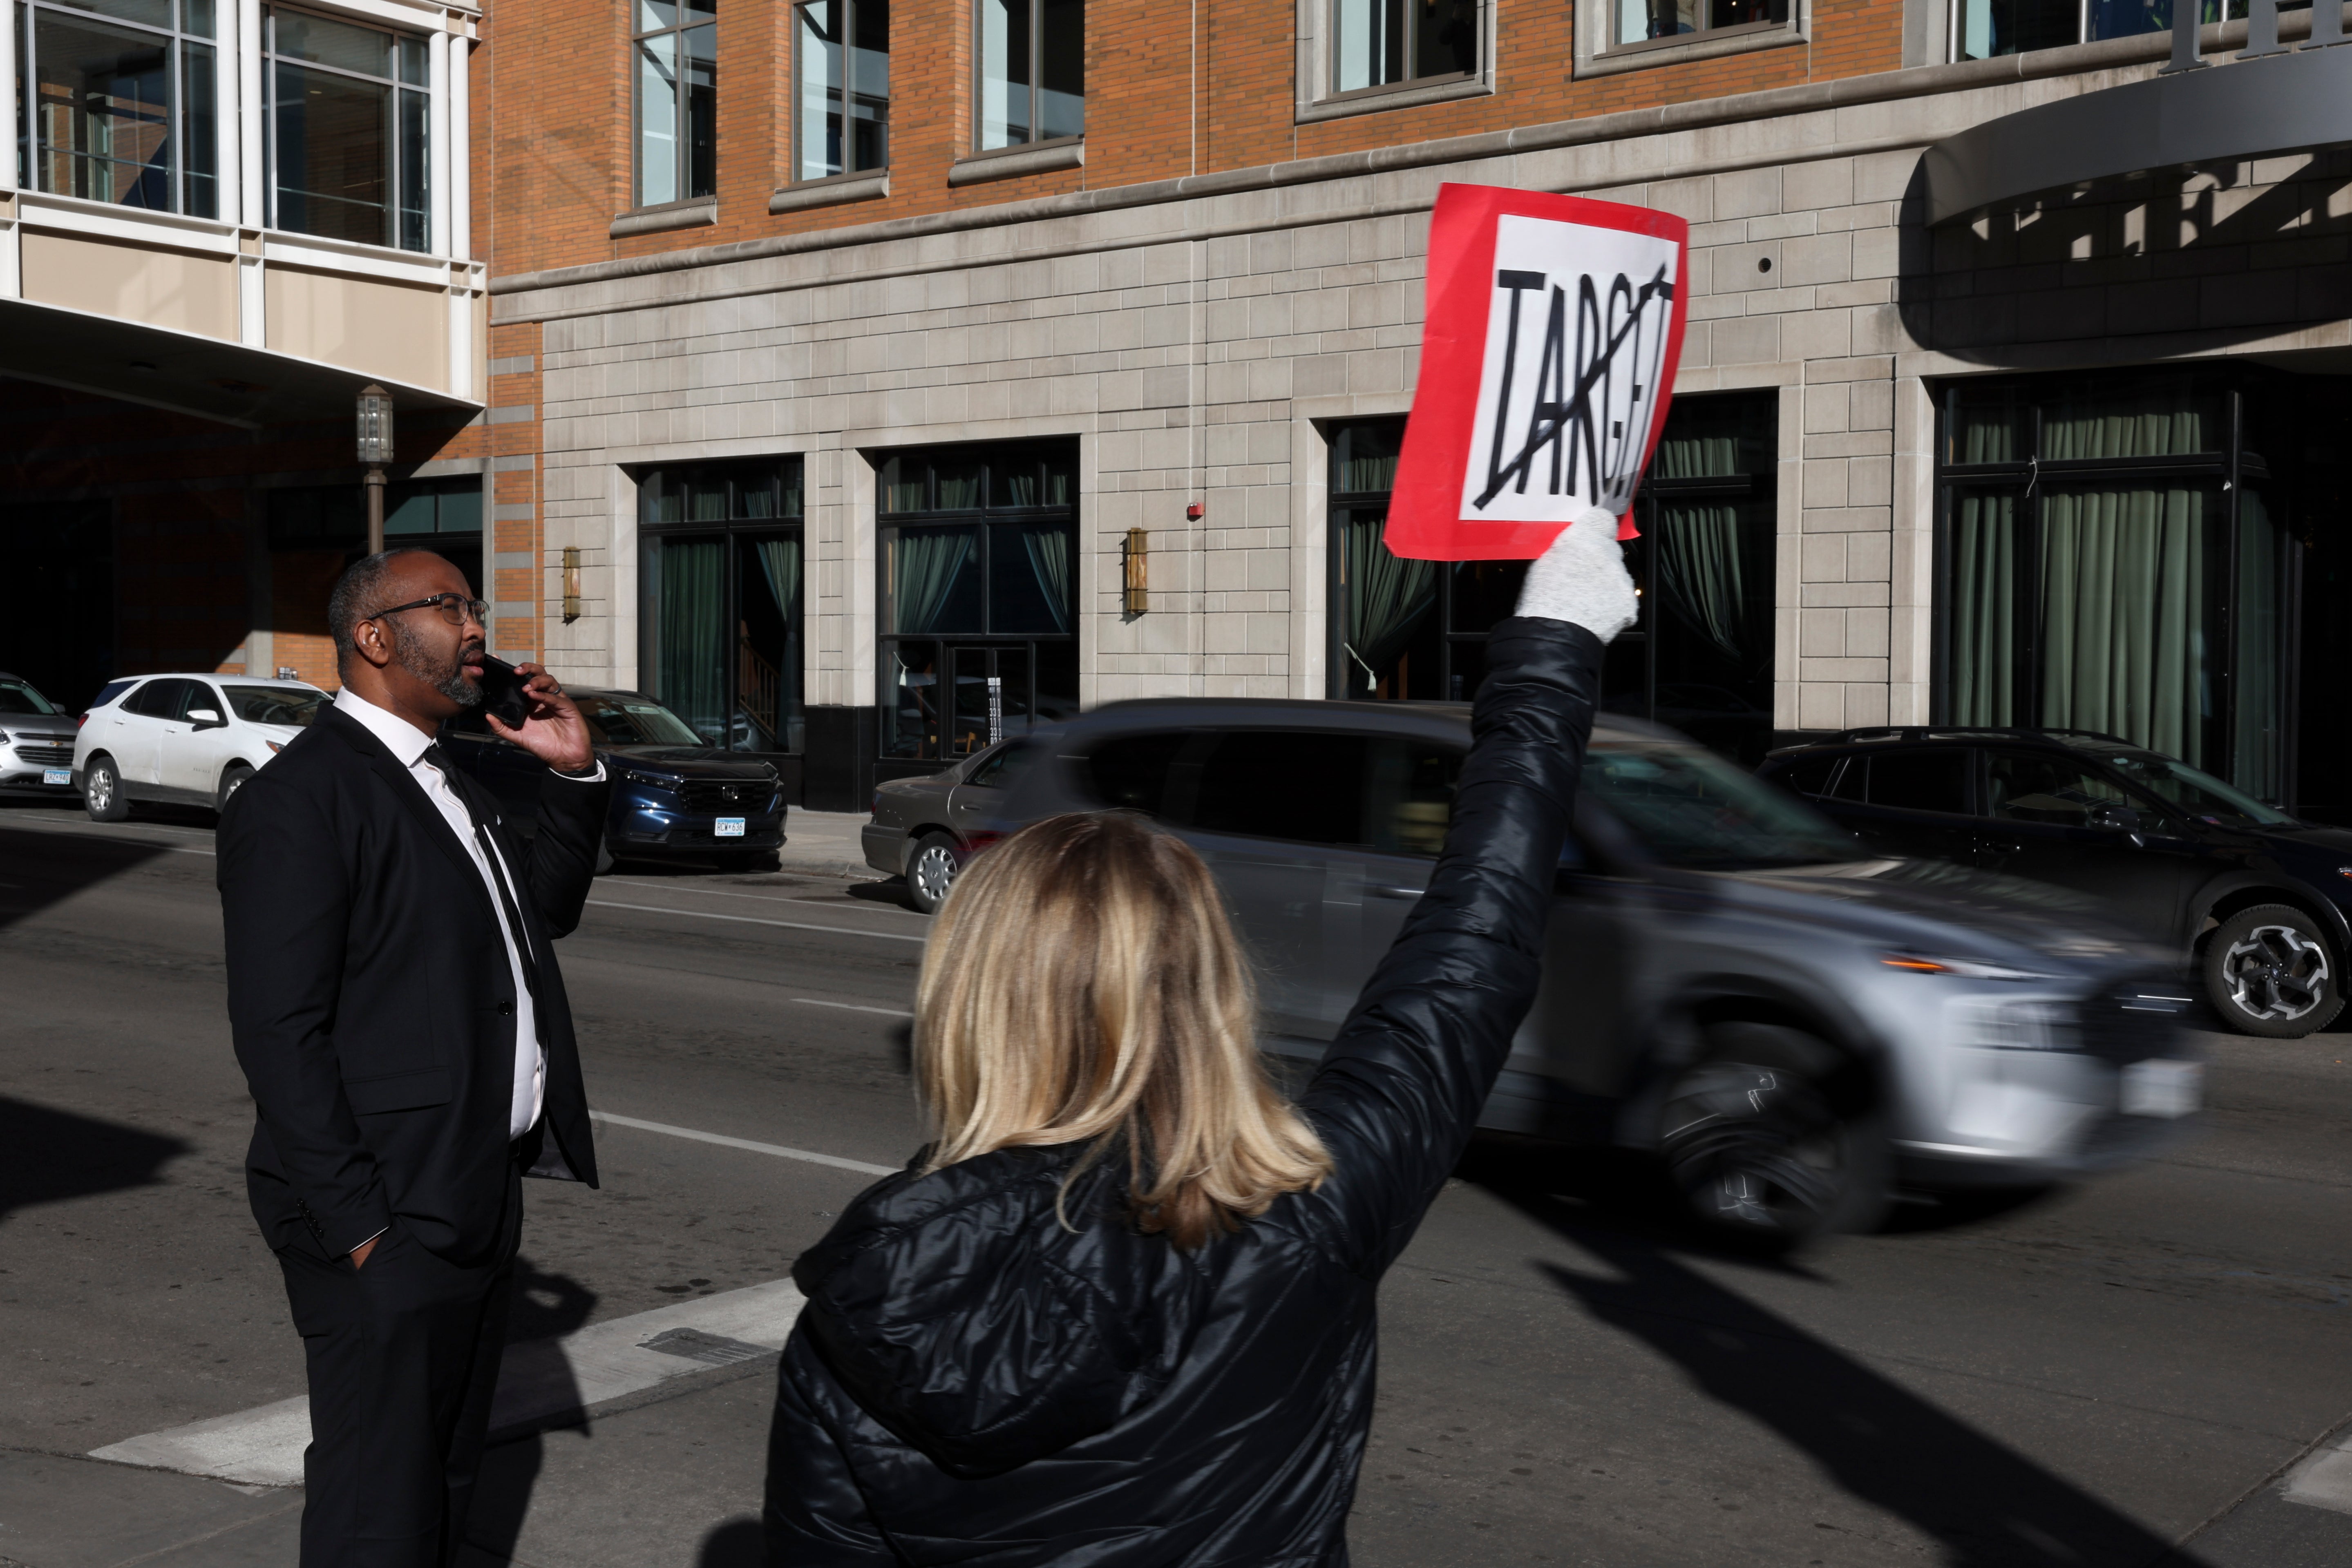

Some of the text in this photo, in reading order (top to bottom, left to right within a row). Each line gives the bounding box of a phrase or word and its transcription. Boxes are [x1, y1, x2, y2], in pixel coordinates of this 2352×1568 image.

[1487, 269, 1673, 506] TARGET
[717, 822, 742, 831] RCW 636
